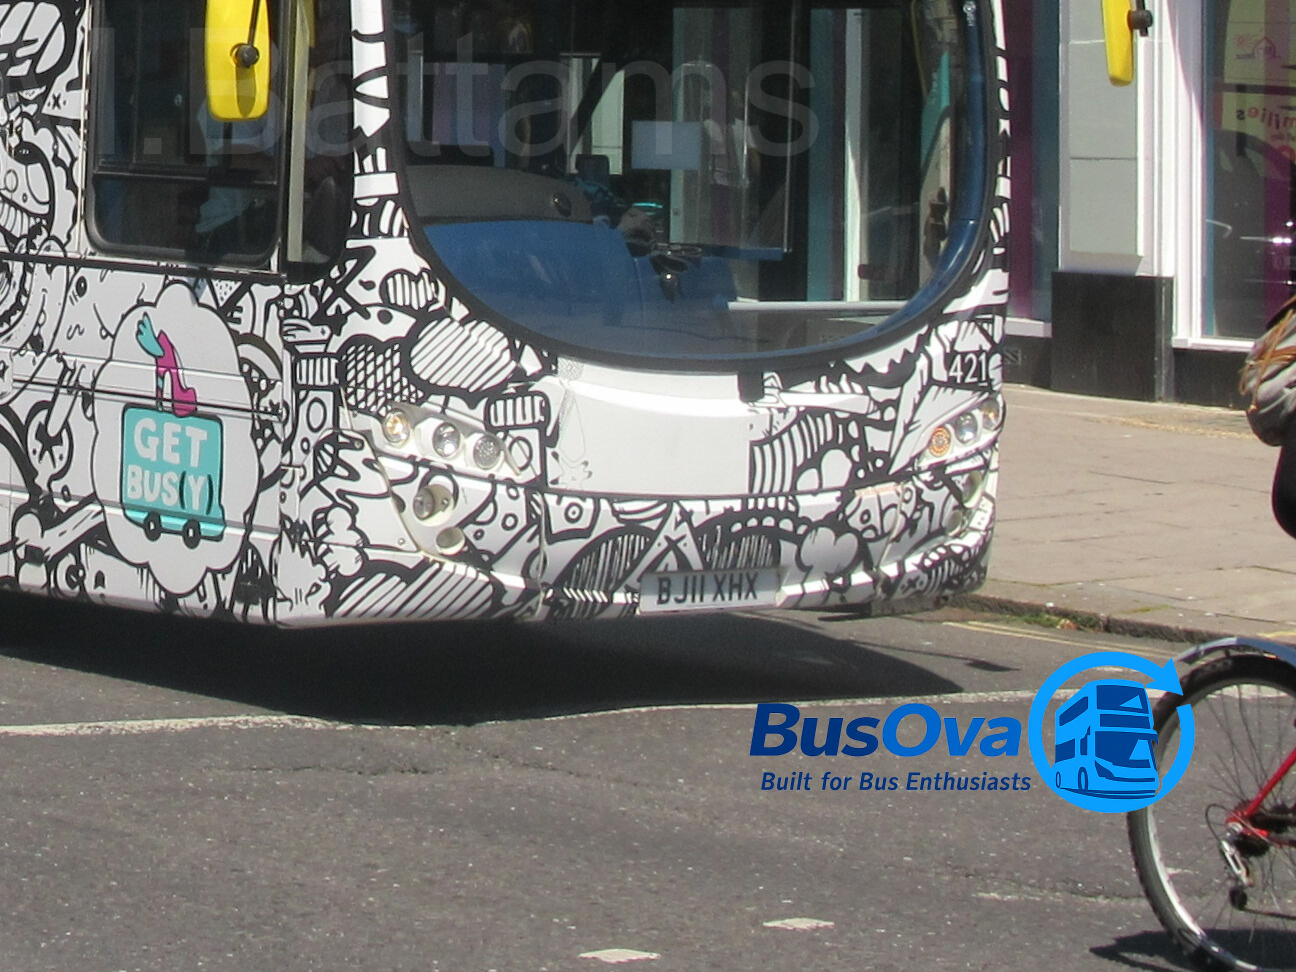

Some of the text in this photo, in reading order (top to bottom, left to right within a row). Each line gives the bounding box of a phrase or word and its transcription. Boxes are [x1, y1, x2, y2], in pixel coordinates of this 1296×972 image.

[948, 352, 988, 384] 421
[133, 417, 208, 468] GET
[127, 465, 214, 515] BUS(Y)
[656, 573, 759, 605] BJ11 XHX
